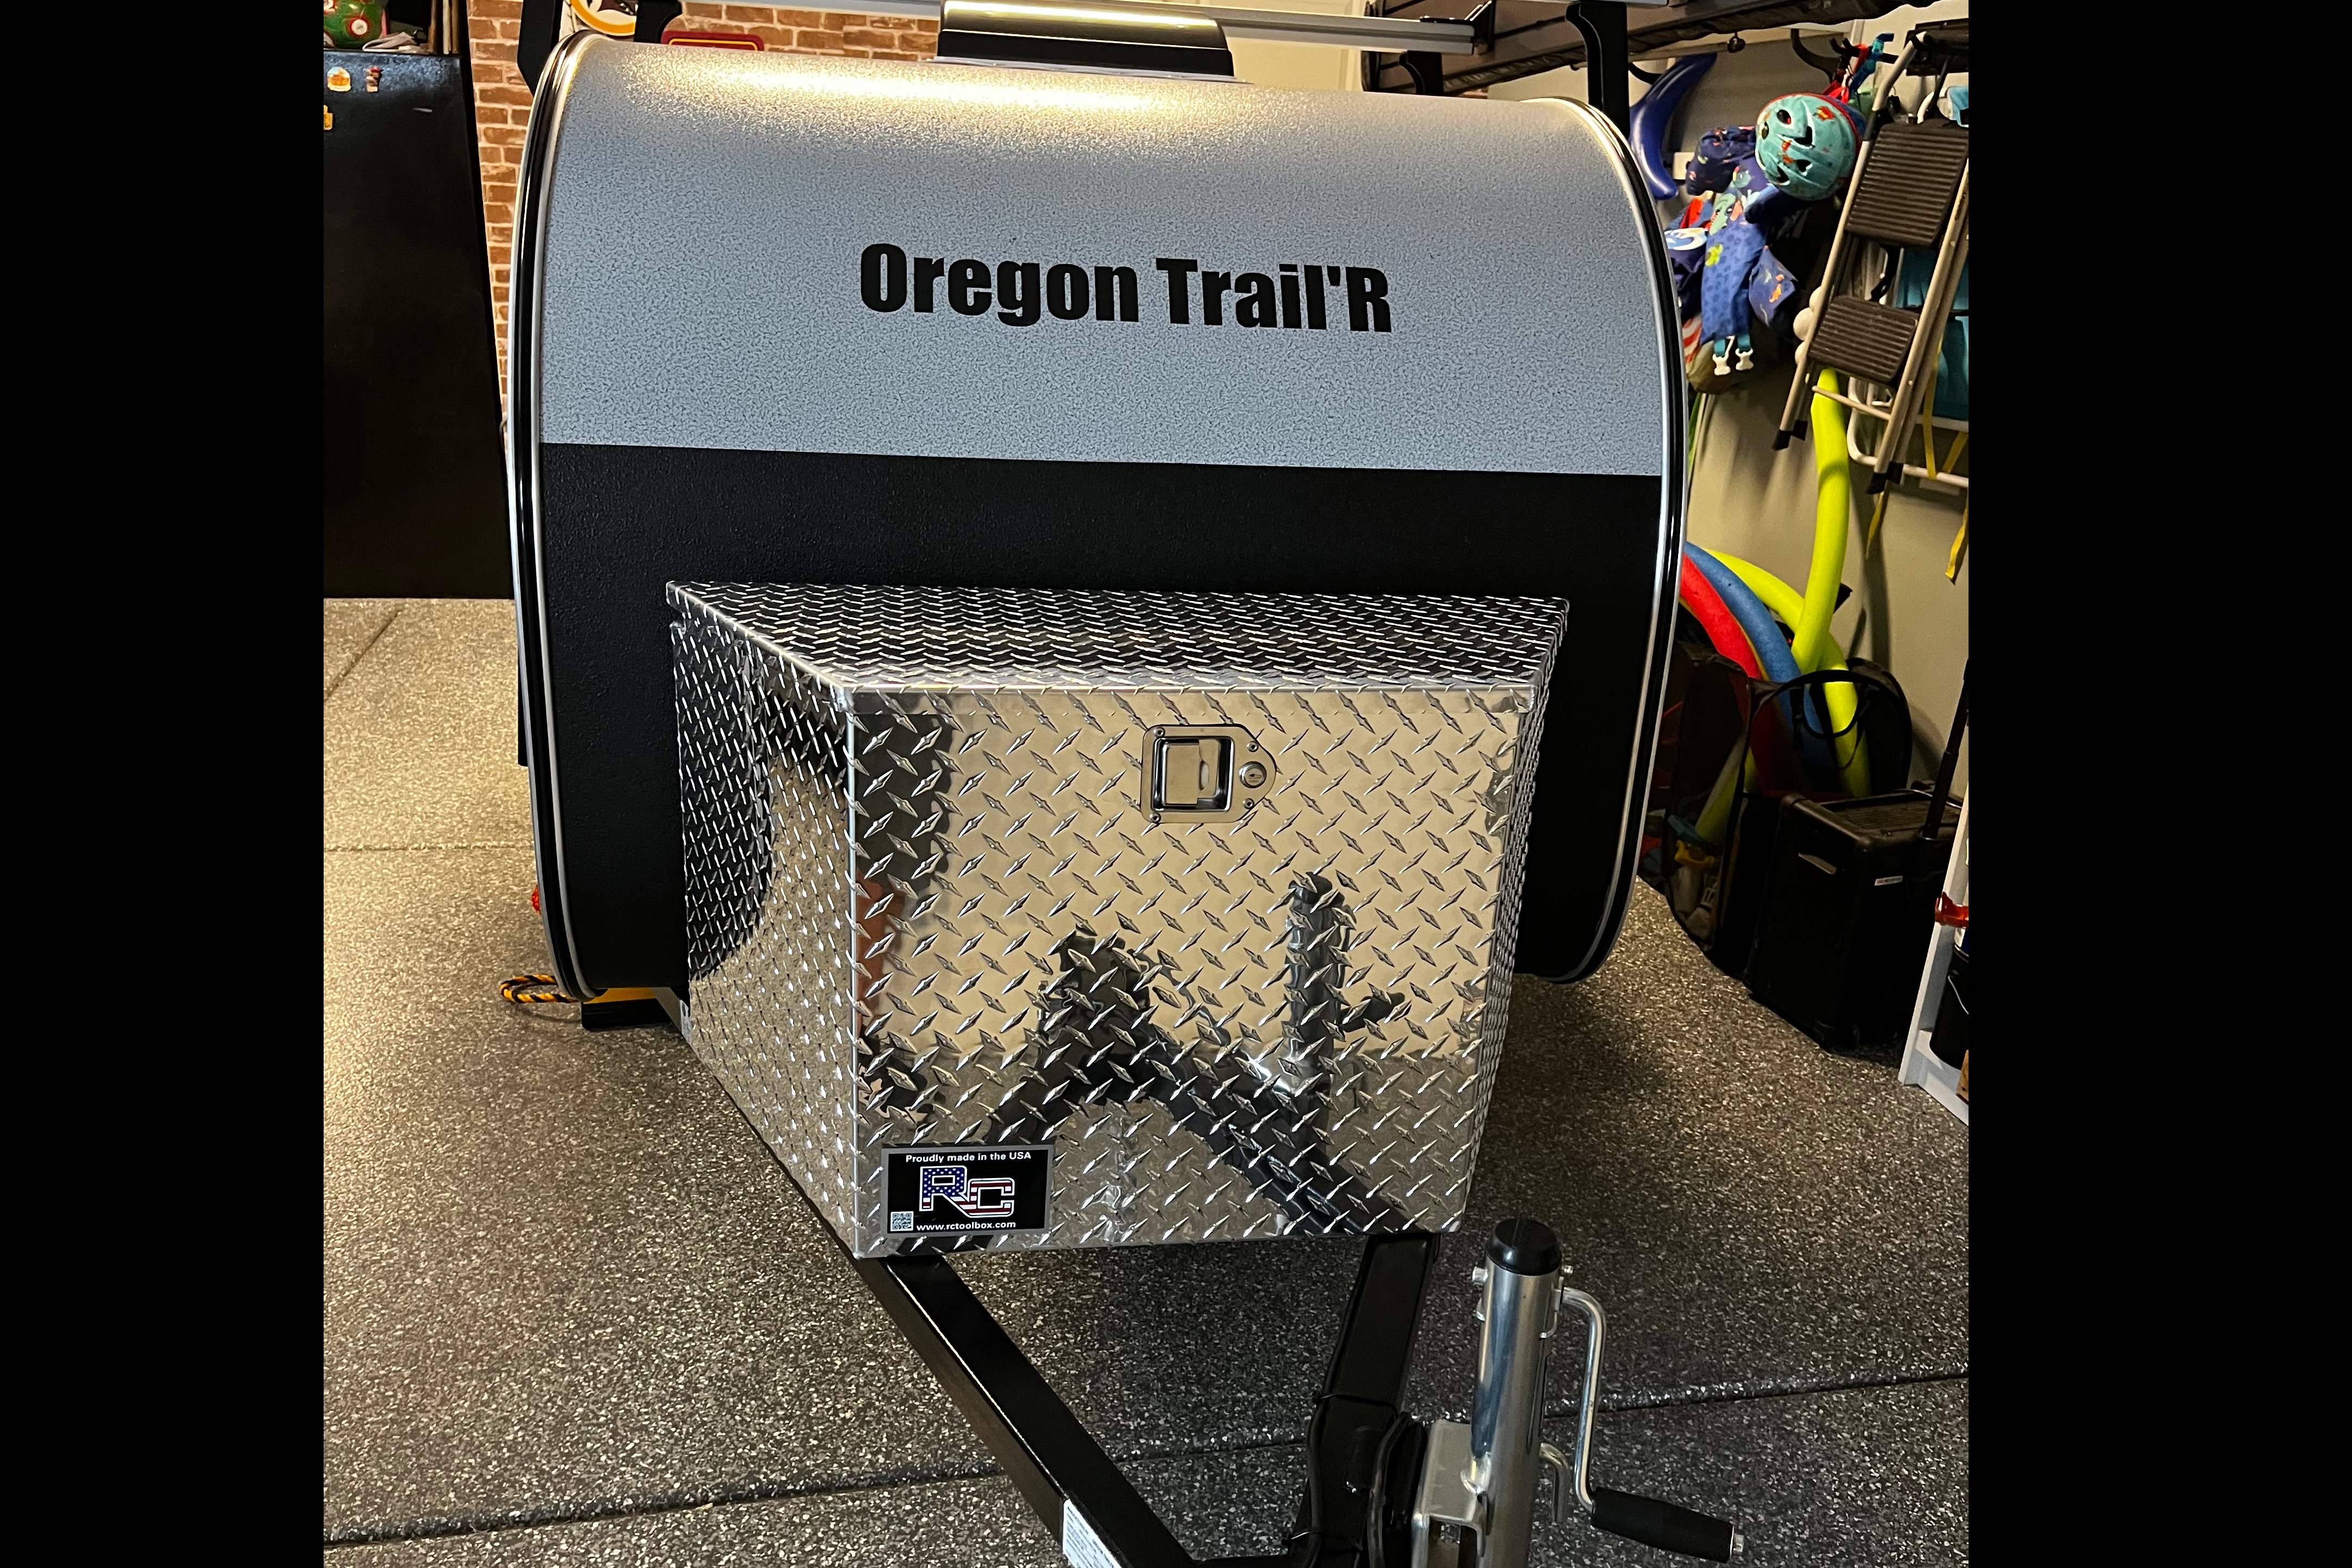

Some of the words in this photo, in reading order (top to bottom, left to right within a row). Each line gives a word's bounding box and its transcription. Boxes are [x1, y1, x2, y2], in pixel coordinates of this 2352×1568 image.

[861, 243, 1139, 326] Oregon
[1155, 258, 1392, 333] Trail'R
[906, 1154, 944, 1163] Proudly
[947, 1153, 975, 1162] made
[1009, 1151, 1031, 1160] USA
[919, 1165, 1016, 1218] RC
[916, 1222, 1016, 1231] www.rctoolbox.com
